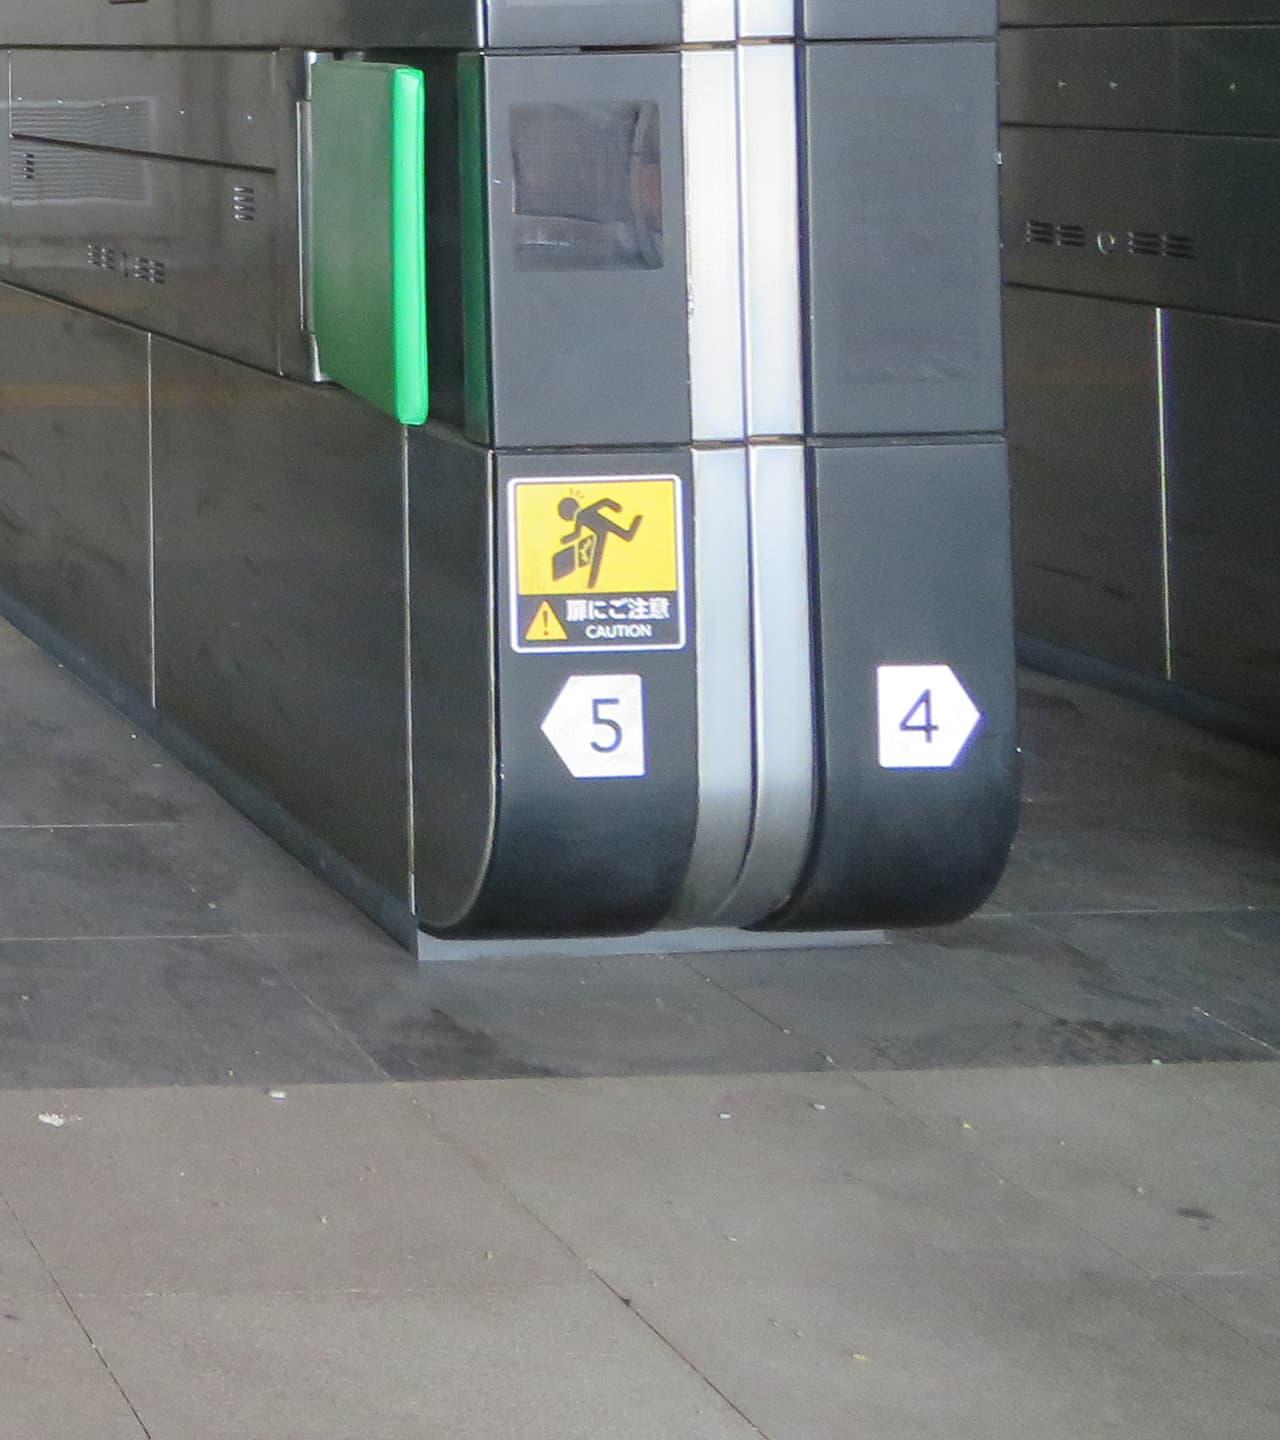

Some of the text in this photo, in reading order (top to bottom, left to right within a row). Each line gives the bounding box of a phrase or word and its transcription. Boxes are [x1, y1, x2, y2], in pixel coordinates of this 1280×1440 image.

[565, 597, 670, 622] 扉にご注意
[585, 623, 653, 640] CAUTION
[589, 697, 624, 754] 5
[898, 688, 940, 744] 4
